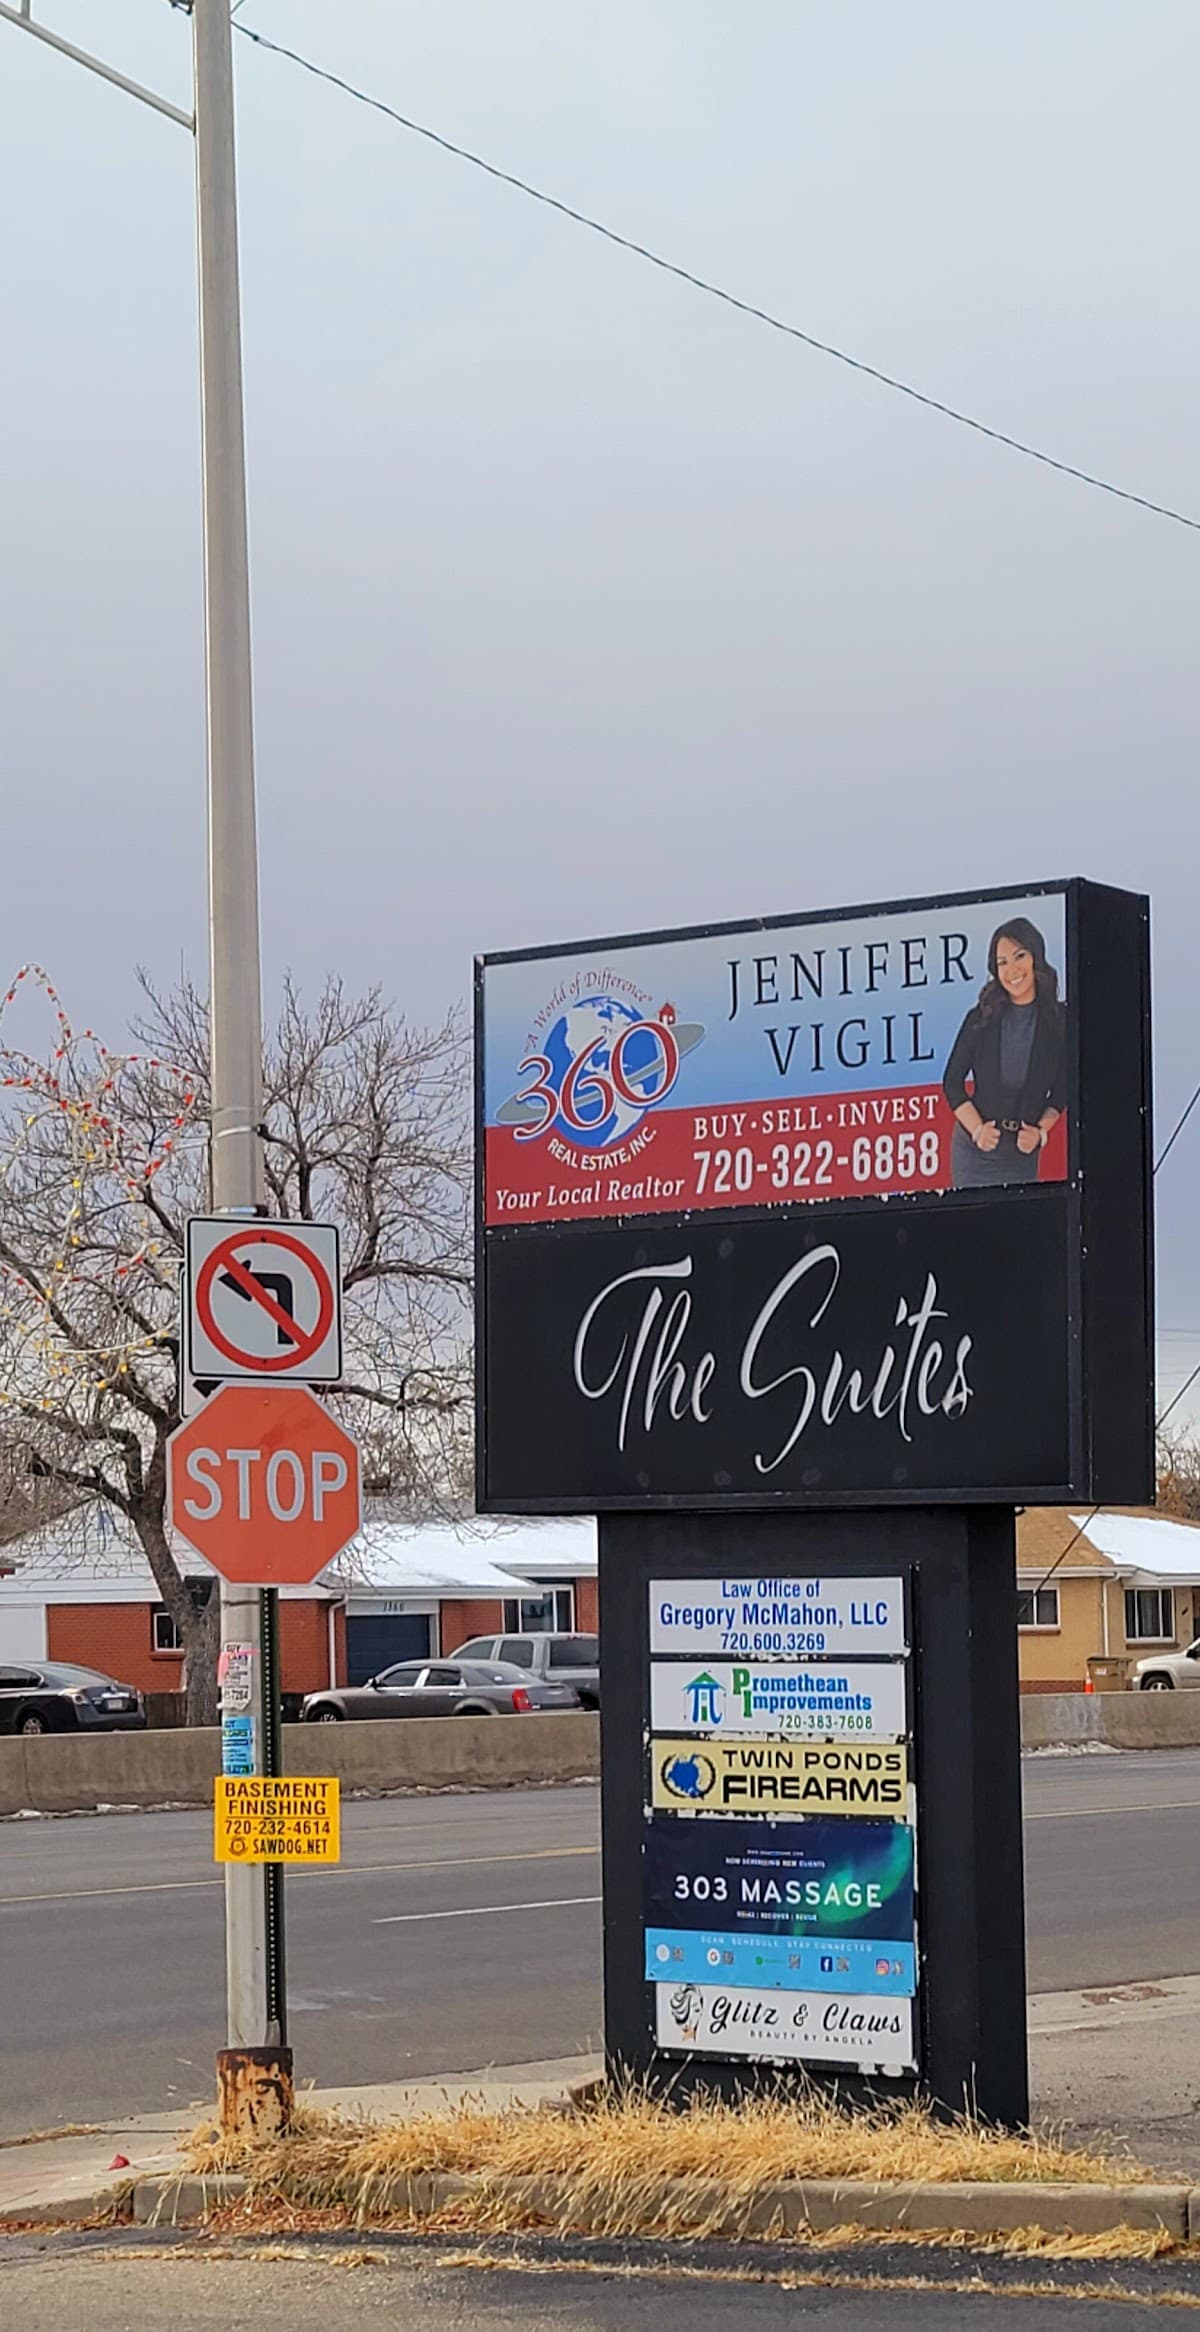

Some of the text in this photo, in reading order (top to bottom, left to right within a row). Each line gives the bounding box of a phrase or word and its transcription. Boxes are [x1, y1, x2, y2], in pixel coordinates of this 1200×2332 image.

[727, 933, 974, 1021] JENIFER
[534, 985, 567, 1029] World
[569, 972, 581, 1001] of
[764, 1012, 935, 1076] VIGIL
[513, 1020, 680, 1140] 360
[548, 1138, 578, 1169] REAL
[630, 1127, 657, 1156] INC.
[693, 1130, 939, 1195] 720-322-6858
[496, 1176, 685, 1211] Your Local Realtor
[573, 1244, 973, 1473] The Suites
[184, 1447, 348, 1522] STOP
[722, 1579, 821, 1598] Law Office of
[660, 1602, 888, 1630] Gregory McMahon, LLC
[720, 1632, 825, 1650] 720.600.3269
[732, 1668, 848, 1695] Promethean
[743, 1690, 872, 1718] Improvements
[778, 1714, 873, 1729] 720-383-7608
[722, 1750, 902, 1771] TWIN PONDS
[225, 1782, 329, 1798] BASEMENT
[722, 1775, 902, 1803] FIREARMS
[229, 1800, 326, 1815] FINISHING
[225, 1820, 331, 1835] 720-232-4614
[253, 1838, 328, 1854] SAWDOG.NET
[674, 1875, 882, 1908] 303 MASSAGE
[709, 1996, 904, 2034] Glitz & Claws
[750, 2030, 874, 2046] BEAUTY BY ANGELA
